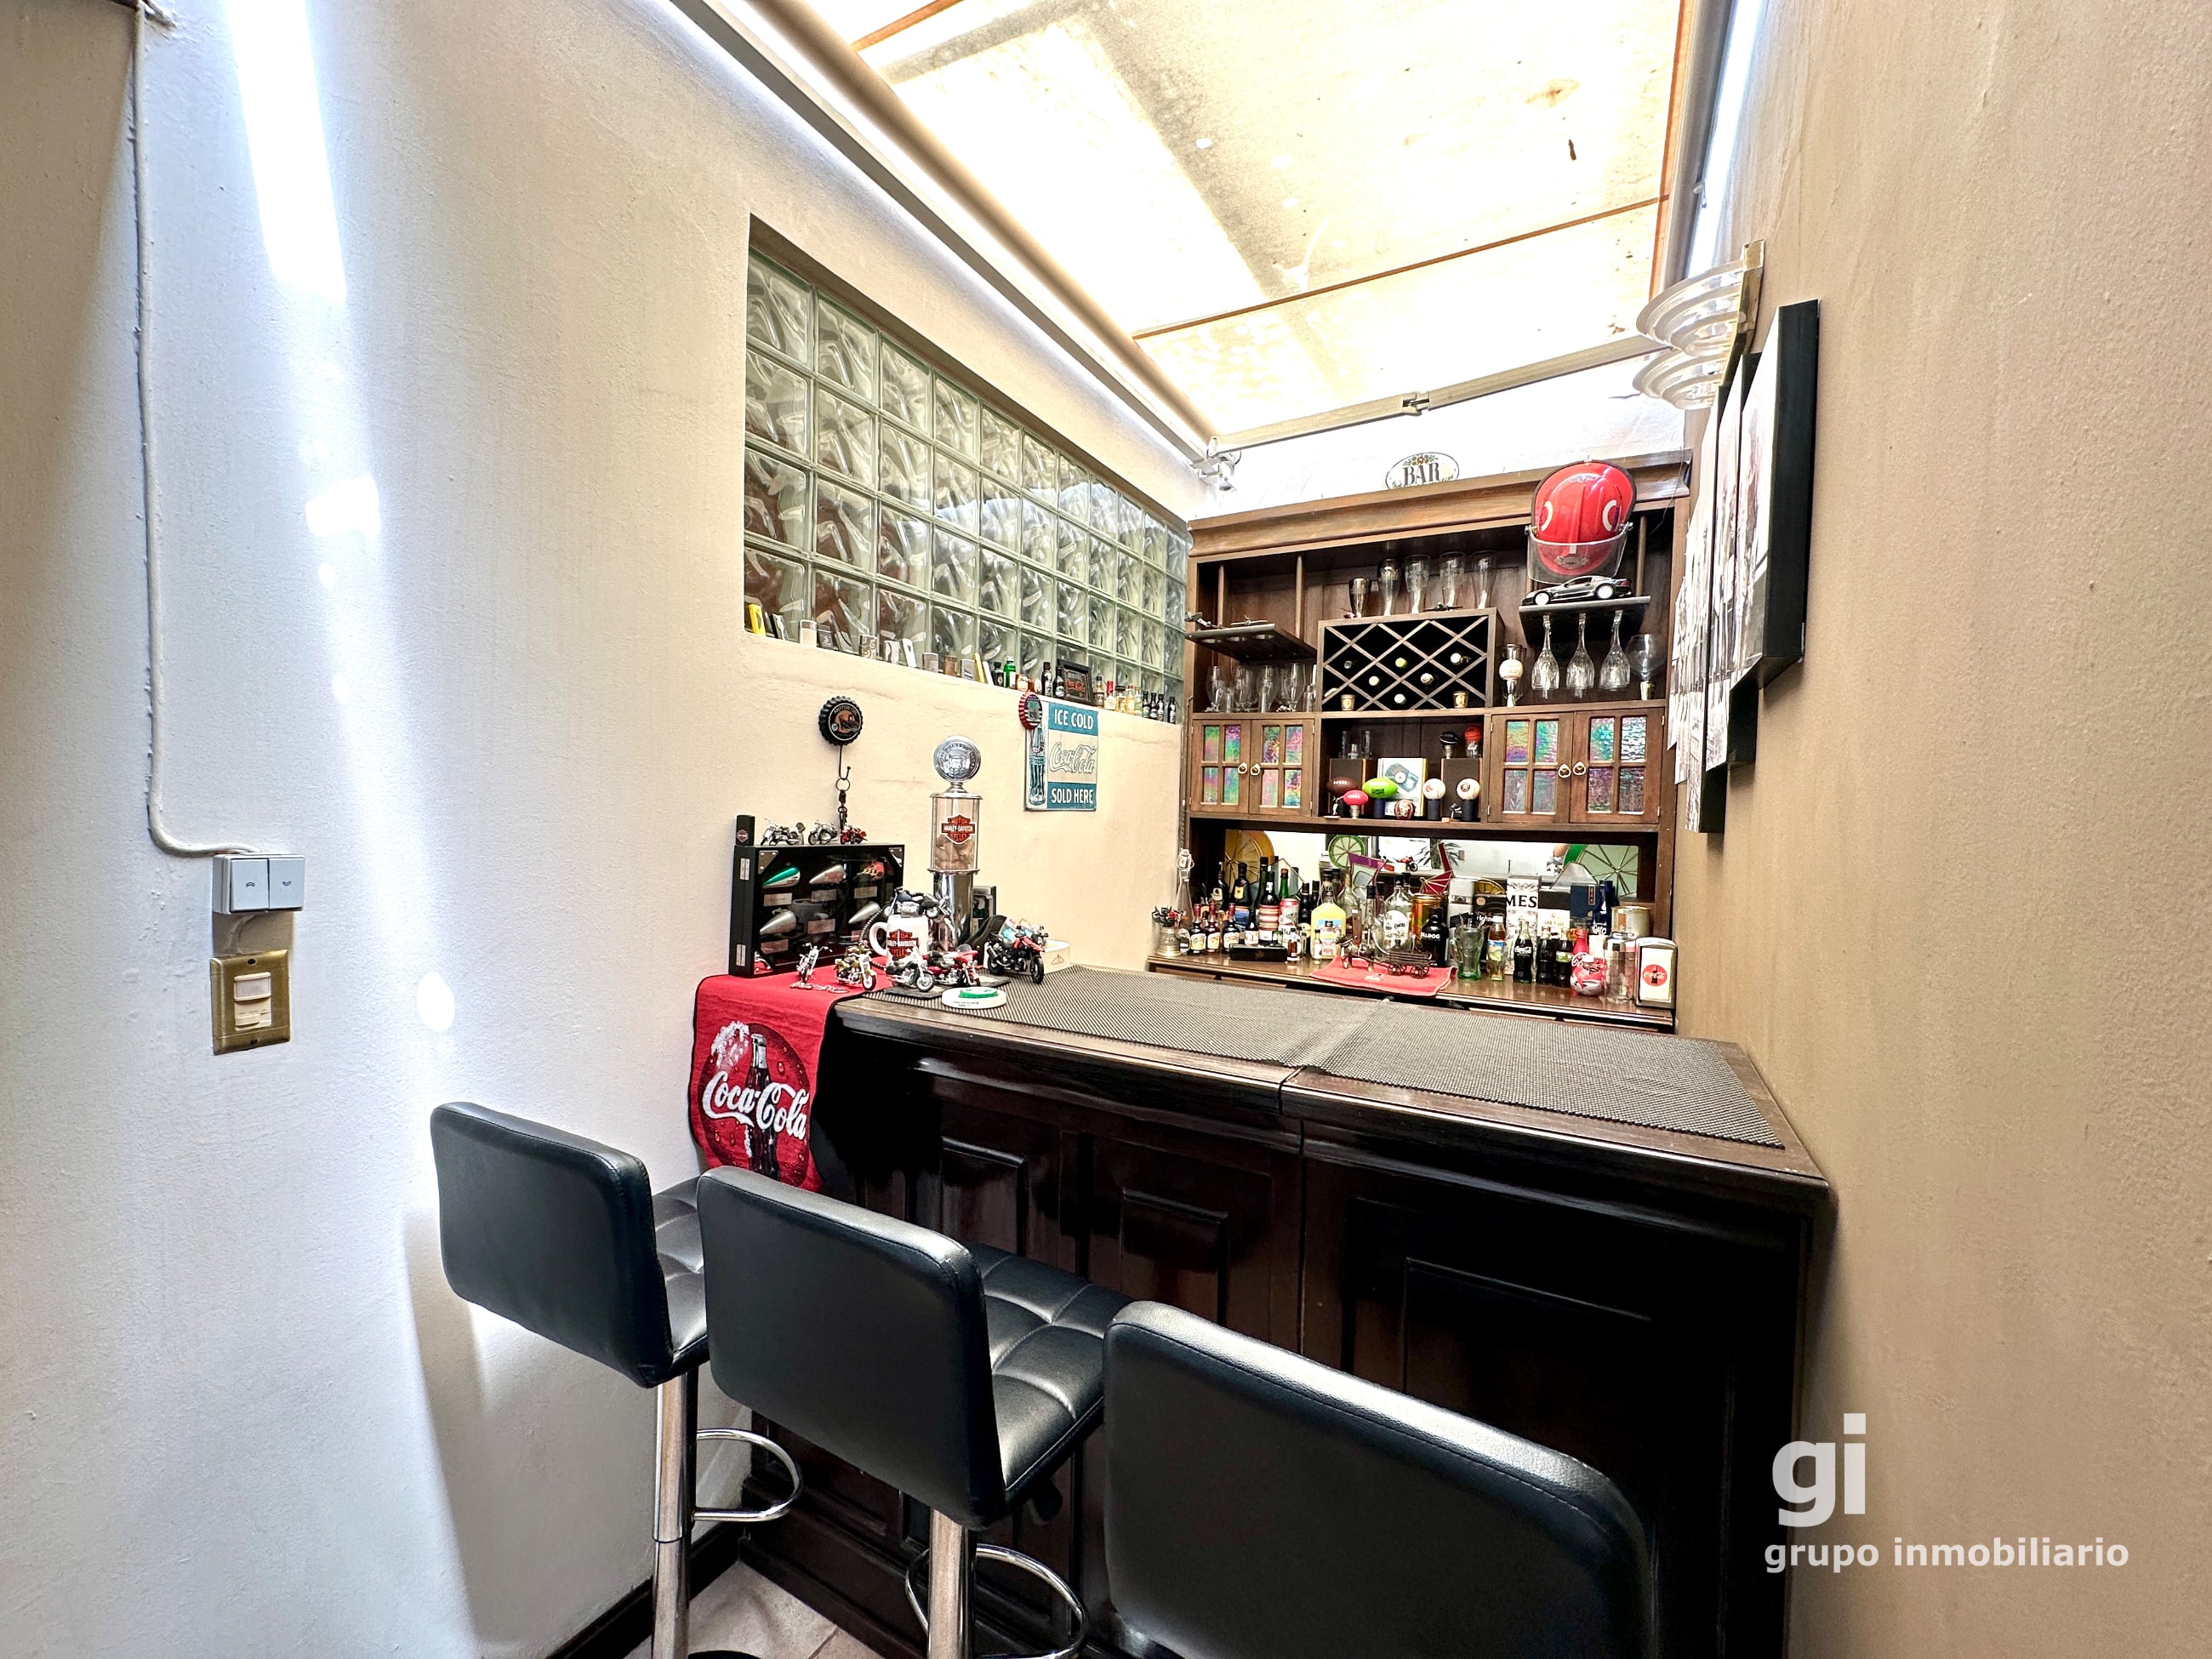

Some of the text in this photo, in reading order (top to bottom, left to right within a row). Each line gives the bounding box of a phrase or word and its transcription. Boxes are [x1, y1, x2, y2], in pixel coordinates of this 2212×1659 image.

[1402, 462, 1440, 487] BAR
[834, 705, 851, 715] MOTOR
[1054, 709, 1094, 730] ICE COLD
[1049, 742, 1097, 775] Coca-Cola
[1052, 788, 1094, 804] SOLD HERE
[701, 1070, 810, 1141] Coca-Cola
